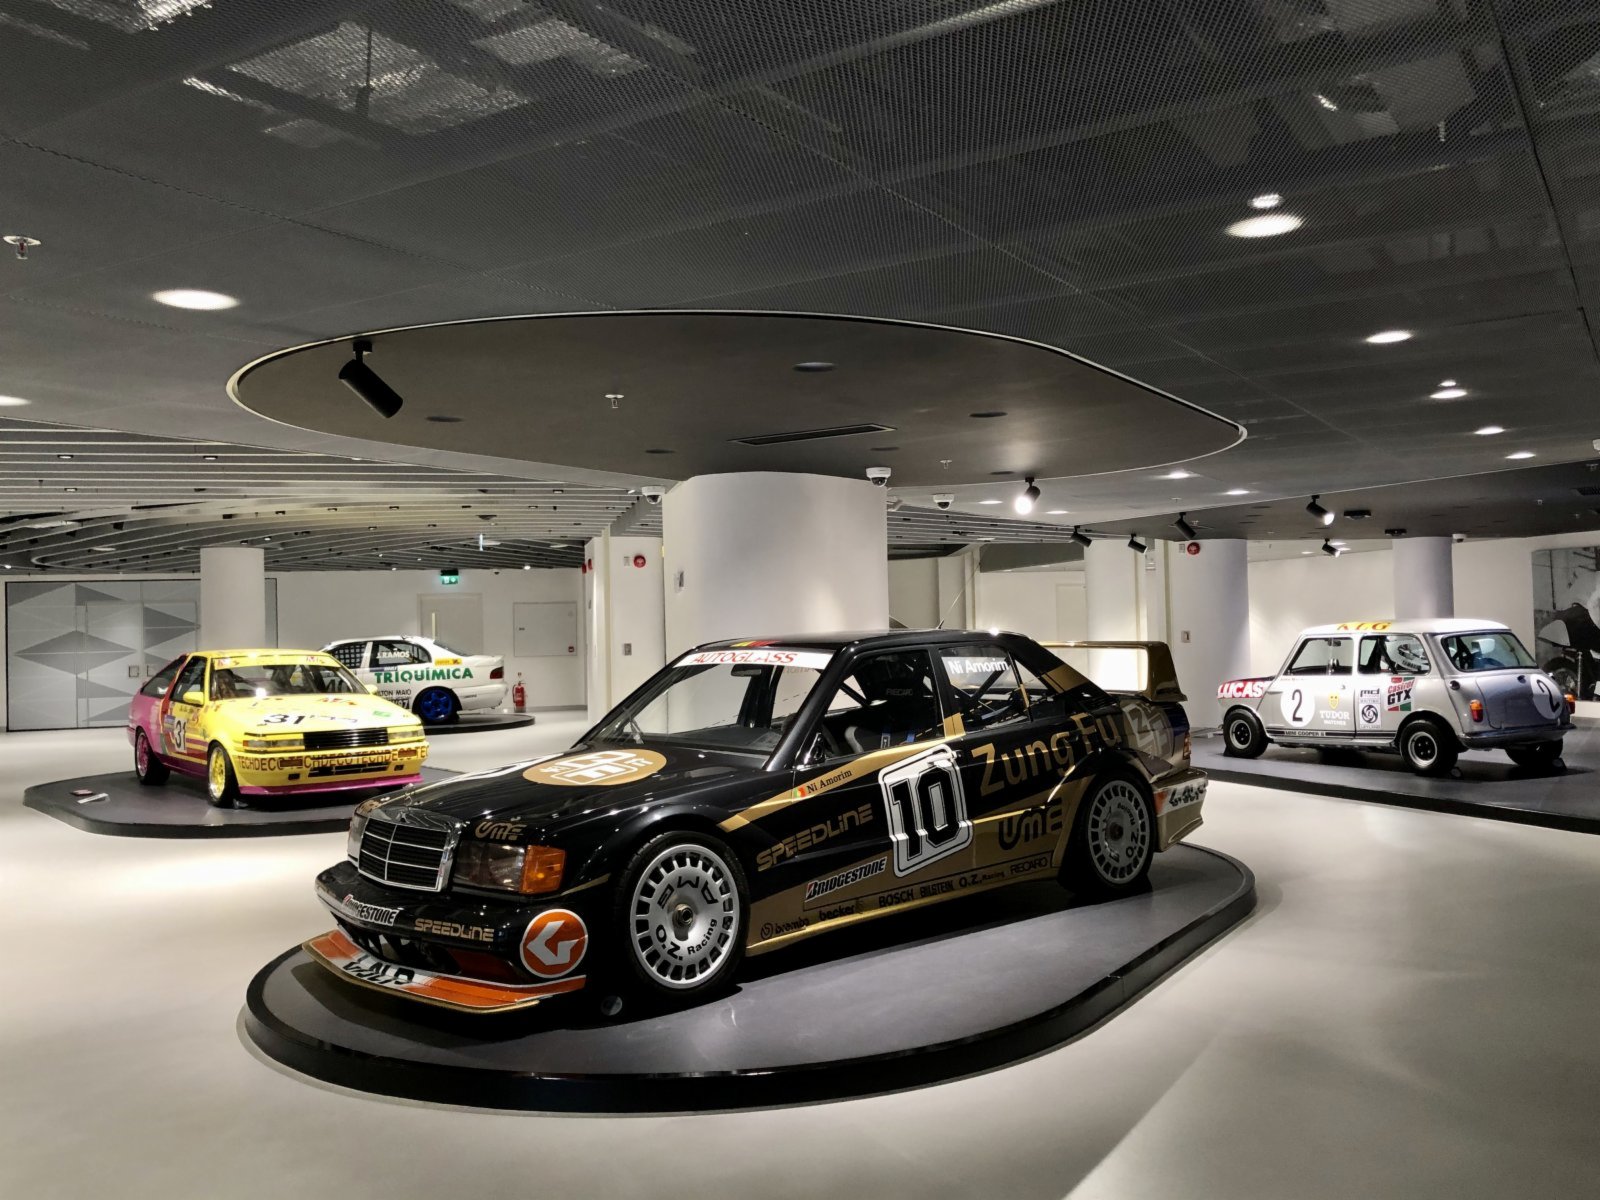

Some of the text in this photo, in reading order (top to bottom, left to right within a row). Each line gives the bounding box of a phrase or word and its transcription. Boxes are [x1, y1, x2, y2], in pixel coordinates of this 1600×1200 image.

[691, 651, 797, 664] AUTOGLASS
[947, 657, 1010, 675] Ni Amorim
[375, 667, 473, 684] TRIQUÍMICA
[1217, 681, 1264, 699] LUCAS
[1388, 688, 1411, 705] GTX
[1536, 679, 1561, 713] 2
[1292, 689, 1303, 721] 2
[1319, 711, 1350, 720] TUDOR
[264, 712, 305, 725] 31
[175, 719, 187, 749] 31
[971, 711, 1123, 797] Zung Fu
[807, 769, 852, 794] Ni Amorim
[889, 766, 960, 861] 10
[756, 803, 874, 872] SPEEDLINE
[805, 857, 888, 901] BRIDGESTONE
[878, 889, 914, 909] BOSCH
[819, 903, 855, 922] becker
[414, 917, 495, 942] SPEEDLINE
[687, 918, 718, 955] Racing
